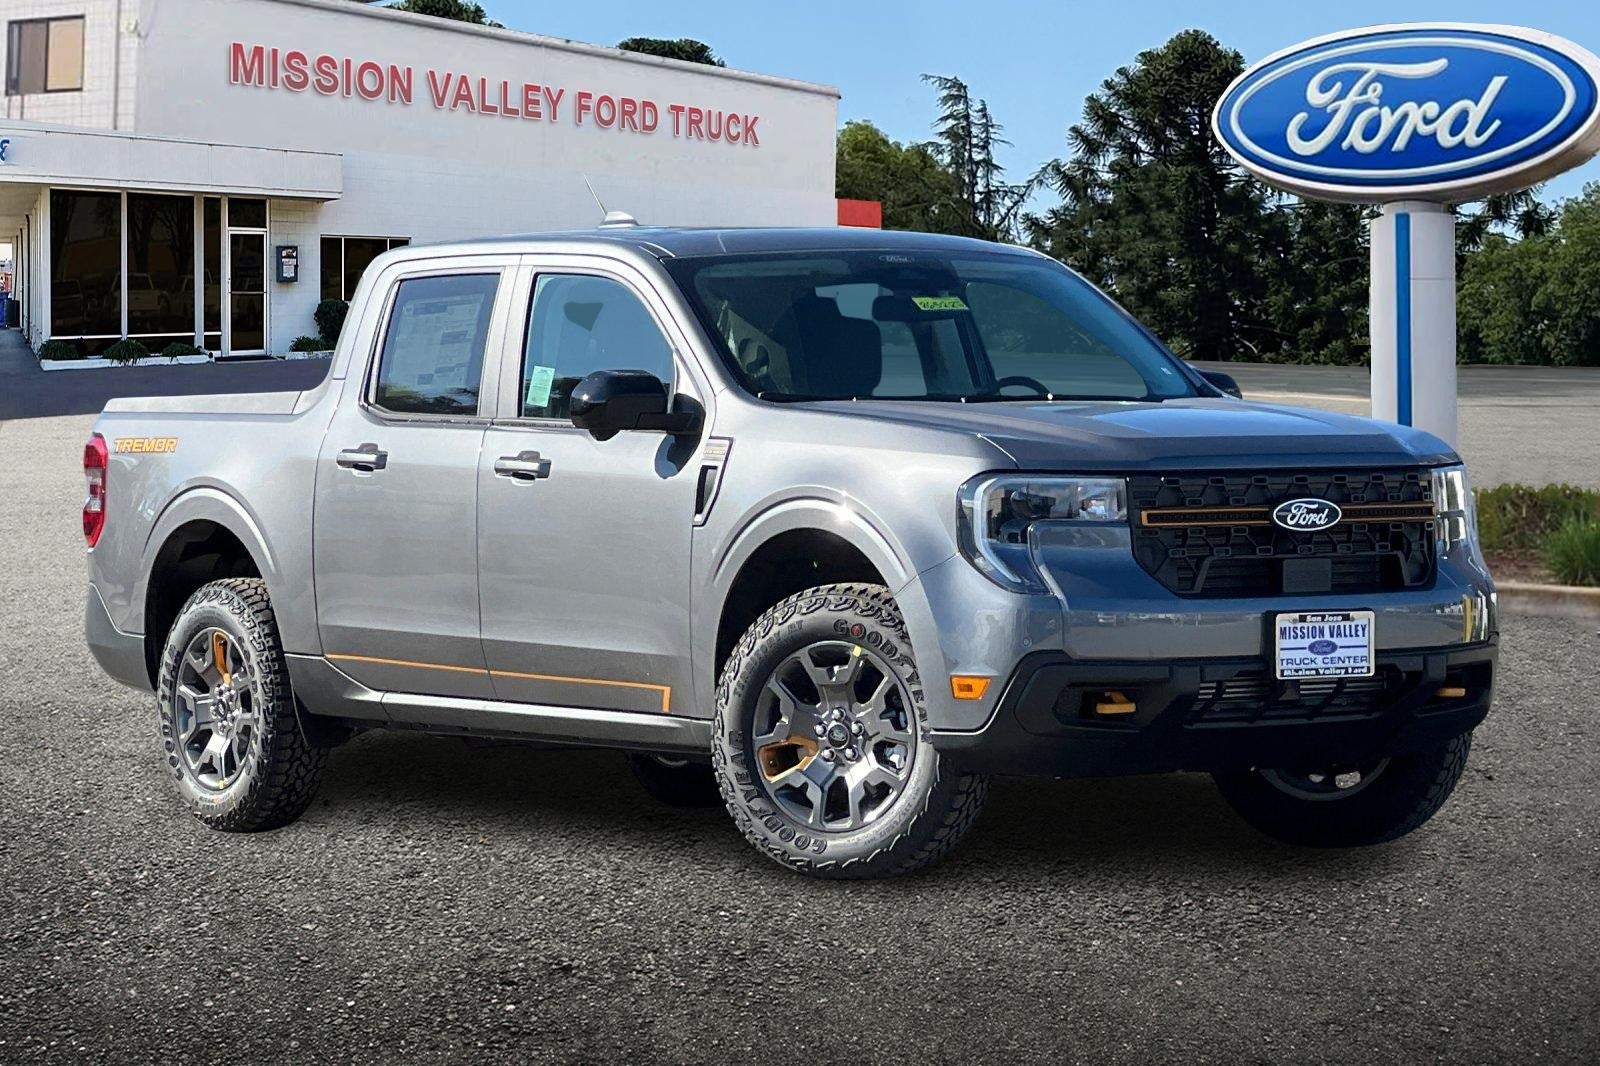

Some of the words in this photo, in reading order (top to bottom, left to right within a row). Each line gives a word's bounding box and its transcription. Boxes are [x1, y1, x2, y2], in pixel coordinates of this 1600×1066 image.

[230, 42, 413, 104] MISSION
[427, 70, 564, 122] VALLEY
[576, 90, 659, 134] FORD
[669, 104, 760, 146] TRUCK
[1286, 57, 1508, 156] Ford
[114, 437, 178, 453] TREMOR
[1286, 502, 1329, 526] Ford
[1306, 614, 1321, 622] San
[1280, 626, 1325, 640] MISSION
[1328, 624, 1367, 639] VALLEY
[1280, 657, 1318, 667] TRUCK
[1322, 655, 1368, 665] CENTER
